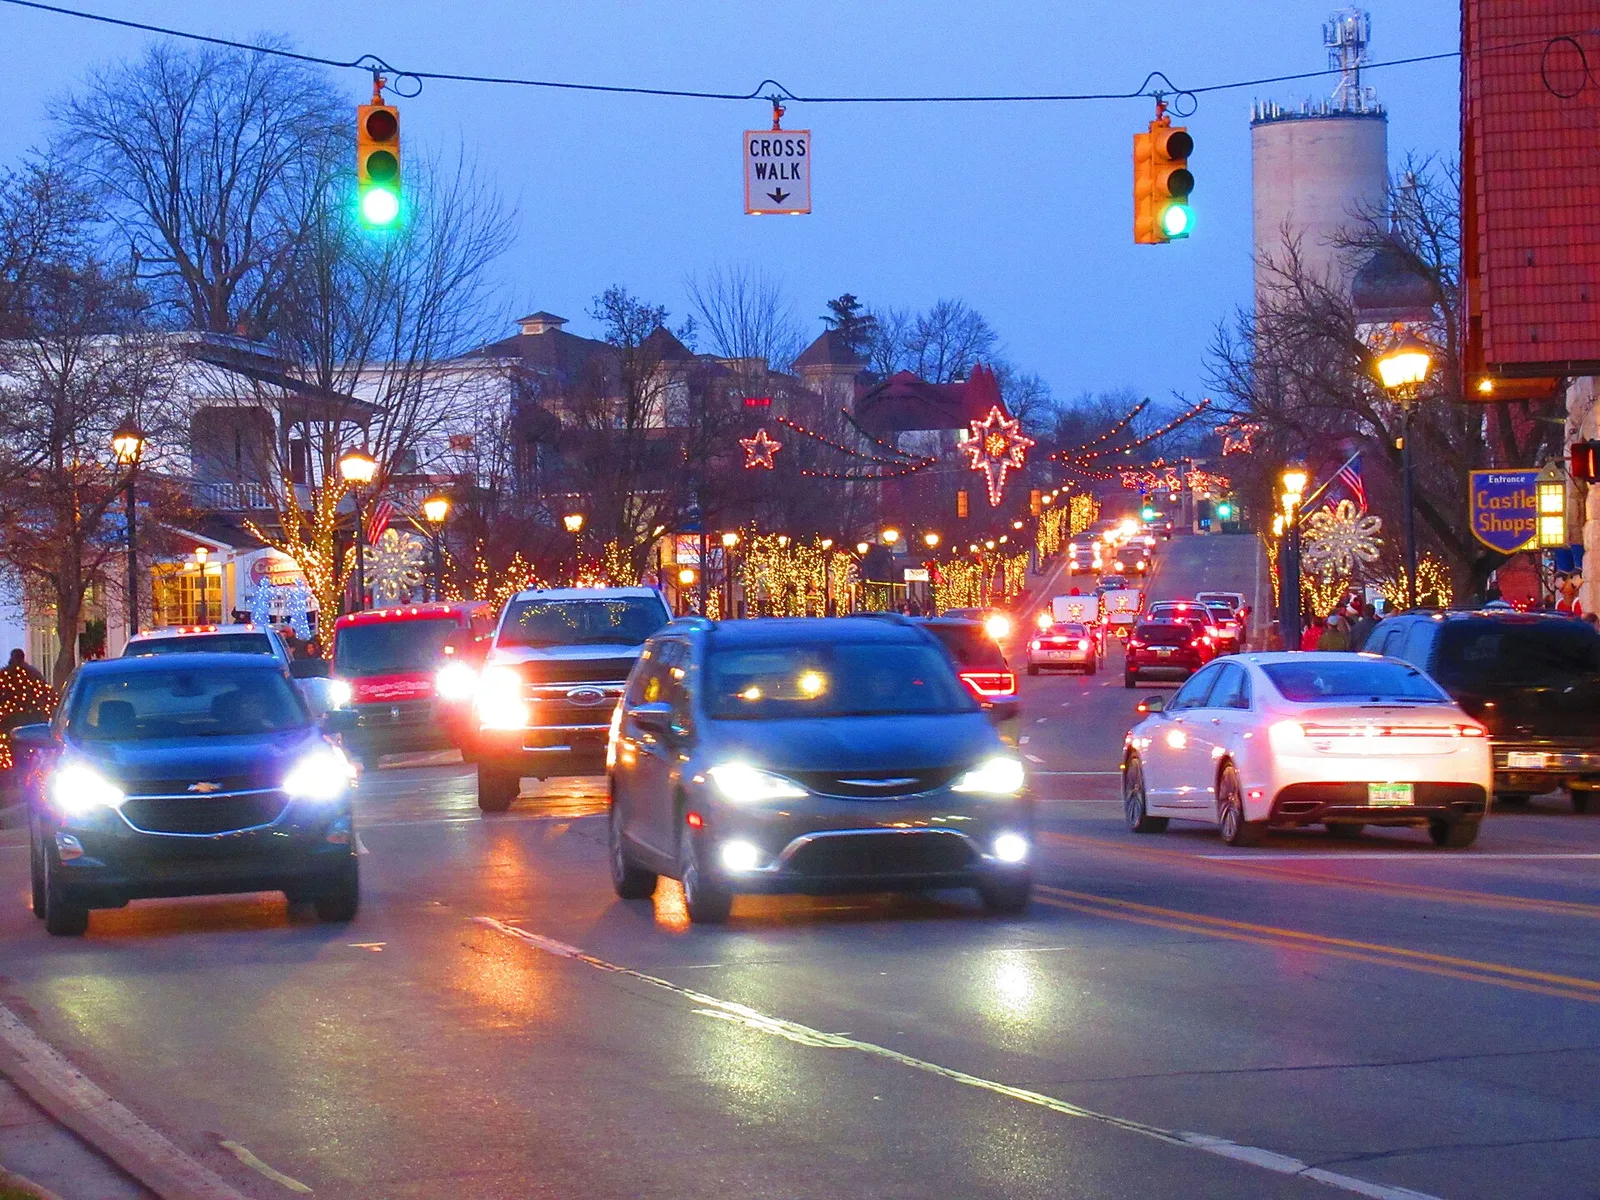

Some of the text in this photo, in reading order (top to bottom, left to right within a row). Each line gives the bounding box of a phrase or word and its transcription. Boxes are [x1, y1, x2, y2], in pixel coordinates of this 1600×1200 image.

[750, 139, 806, 157] CROSS
[755, 162, 801, 180] WALK
[1488, 475, 1526, 484] Entrance
[1477, 489, 1536, 510] Castle
[1479, 512, 1536, 538] Shops
